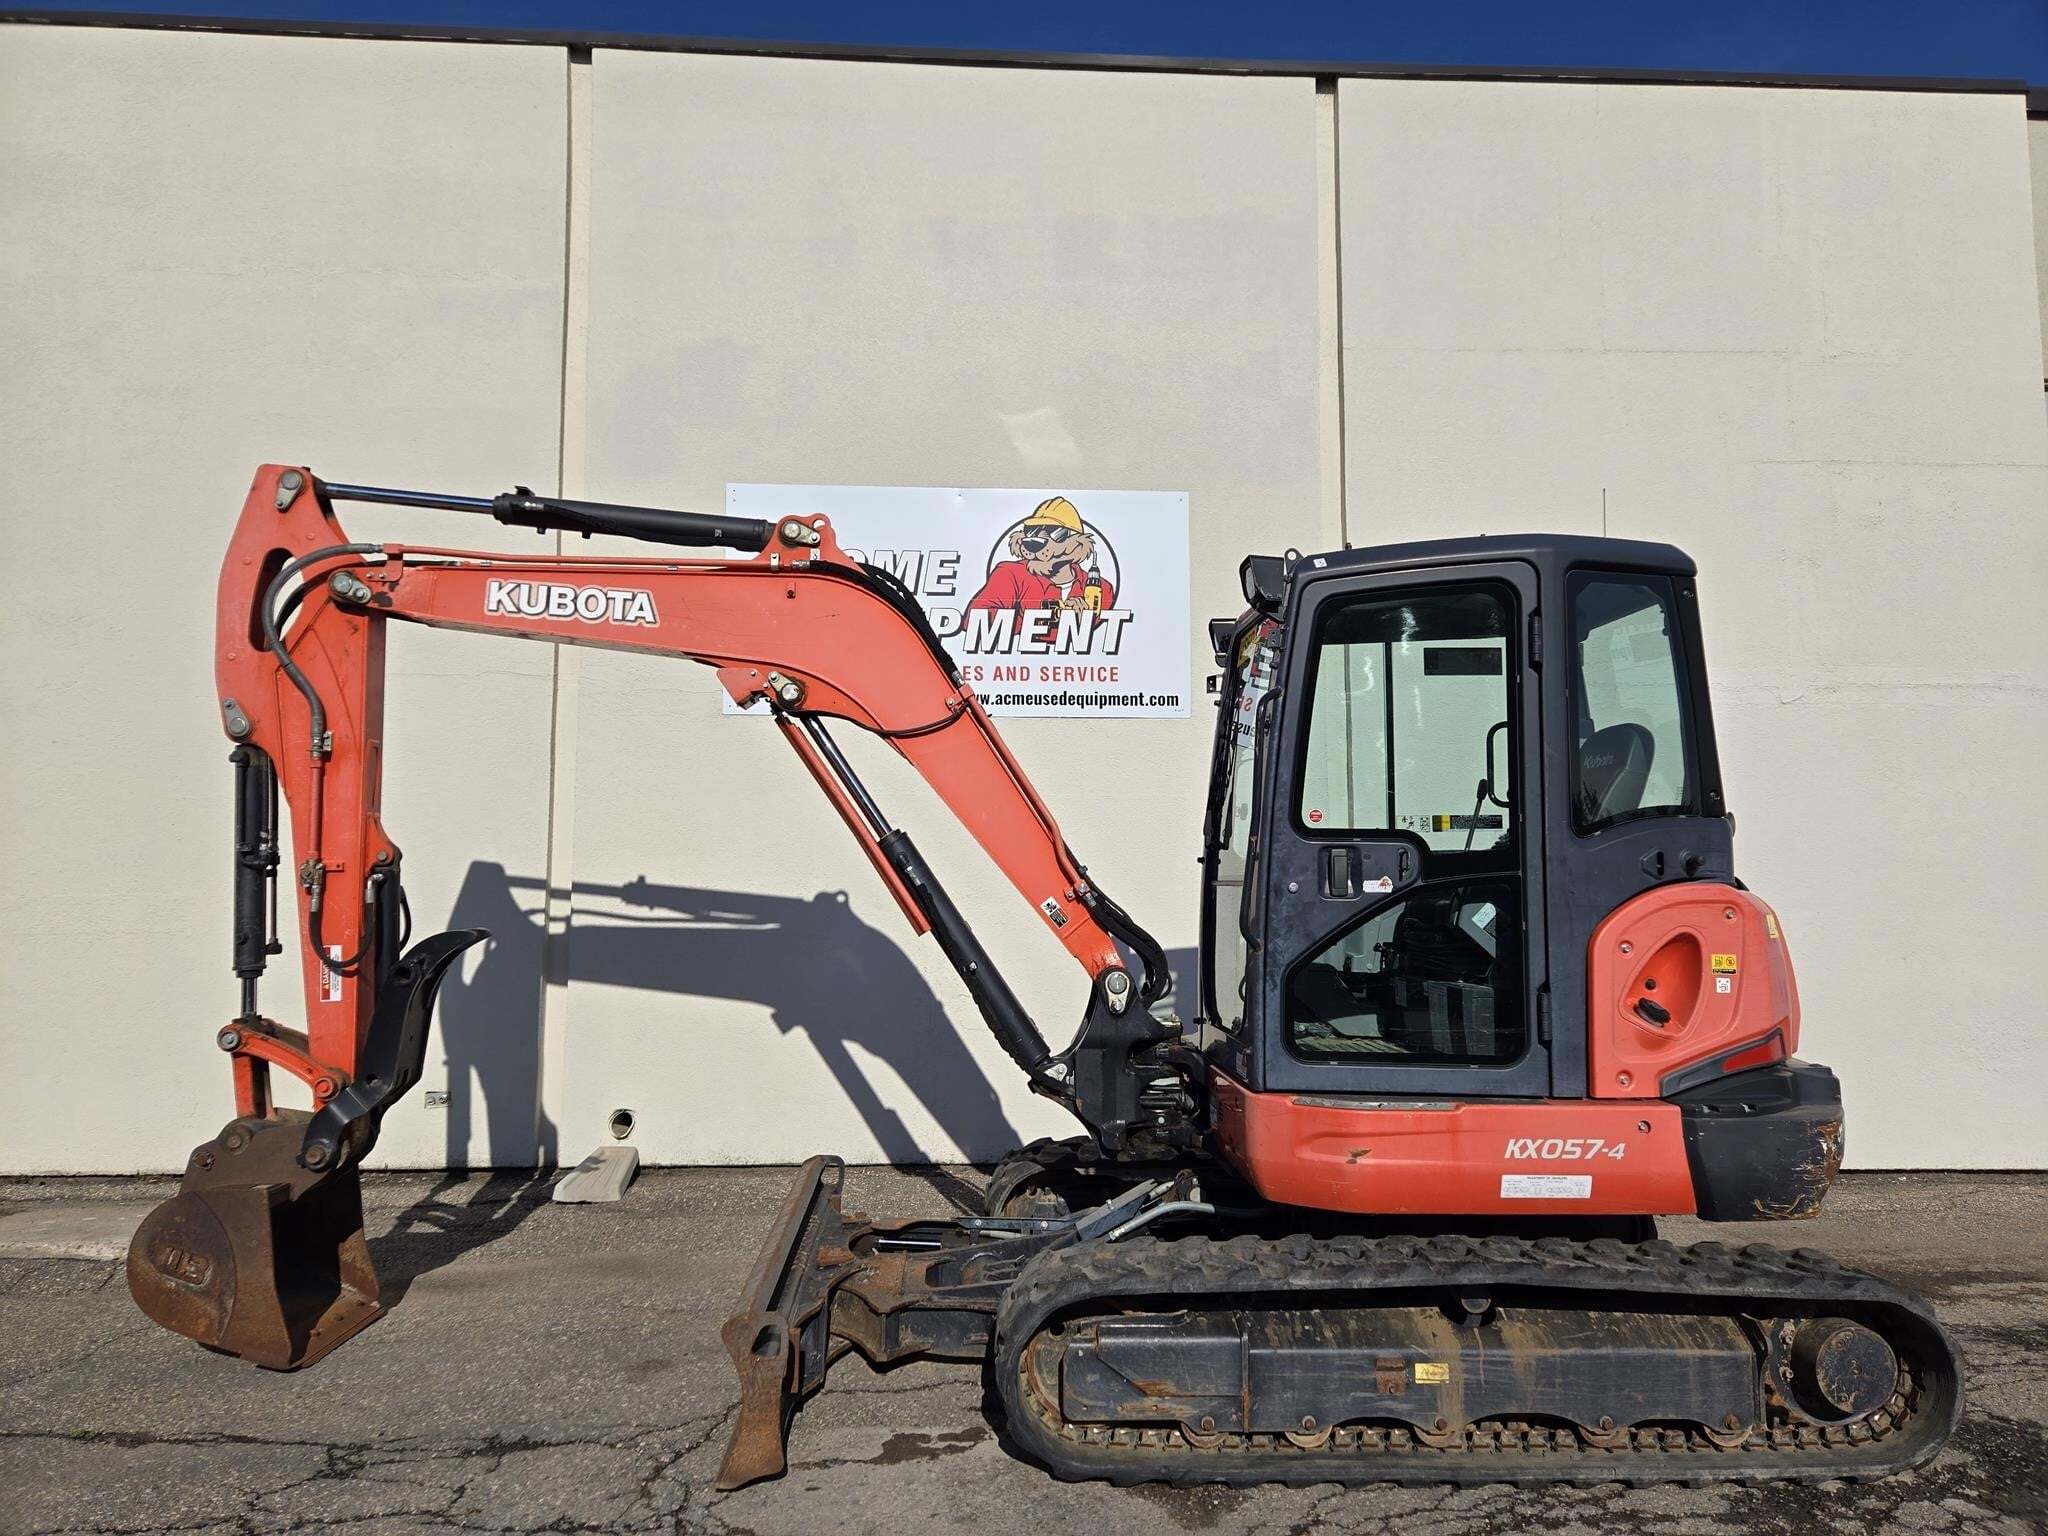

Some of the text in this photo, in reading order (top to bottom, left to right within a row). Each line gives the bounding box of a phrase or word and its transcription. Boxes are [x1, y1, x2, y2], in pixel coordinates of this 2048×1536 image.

[487, 581, 657, 624] KUBOTA
[993, 666, 1031, 682] AND
[1040, 666, 1119, 682] SERVICE
[976, 691, 1179, 709] w.acmeusedequipment.com
[1504, 1138, 1626, 1160] KX057-4
